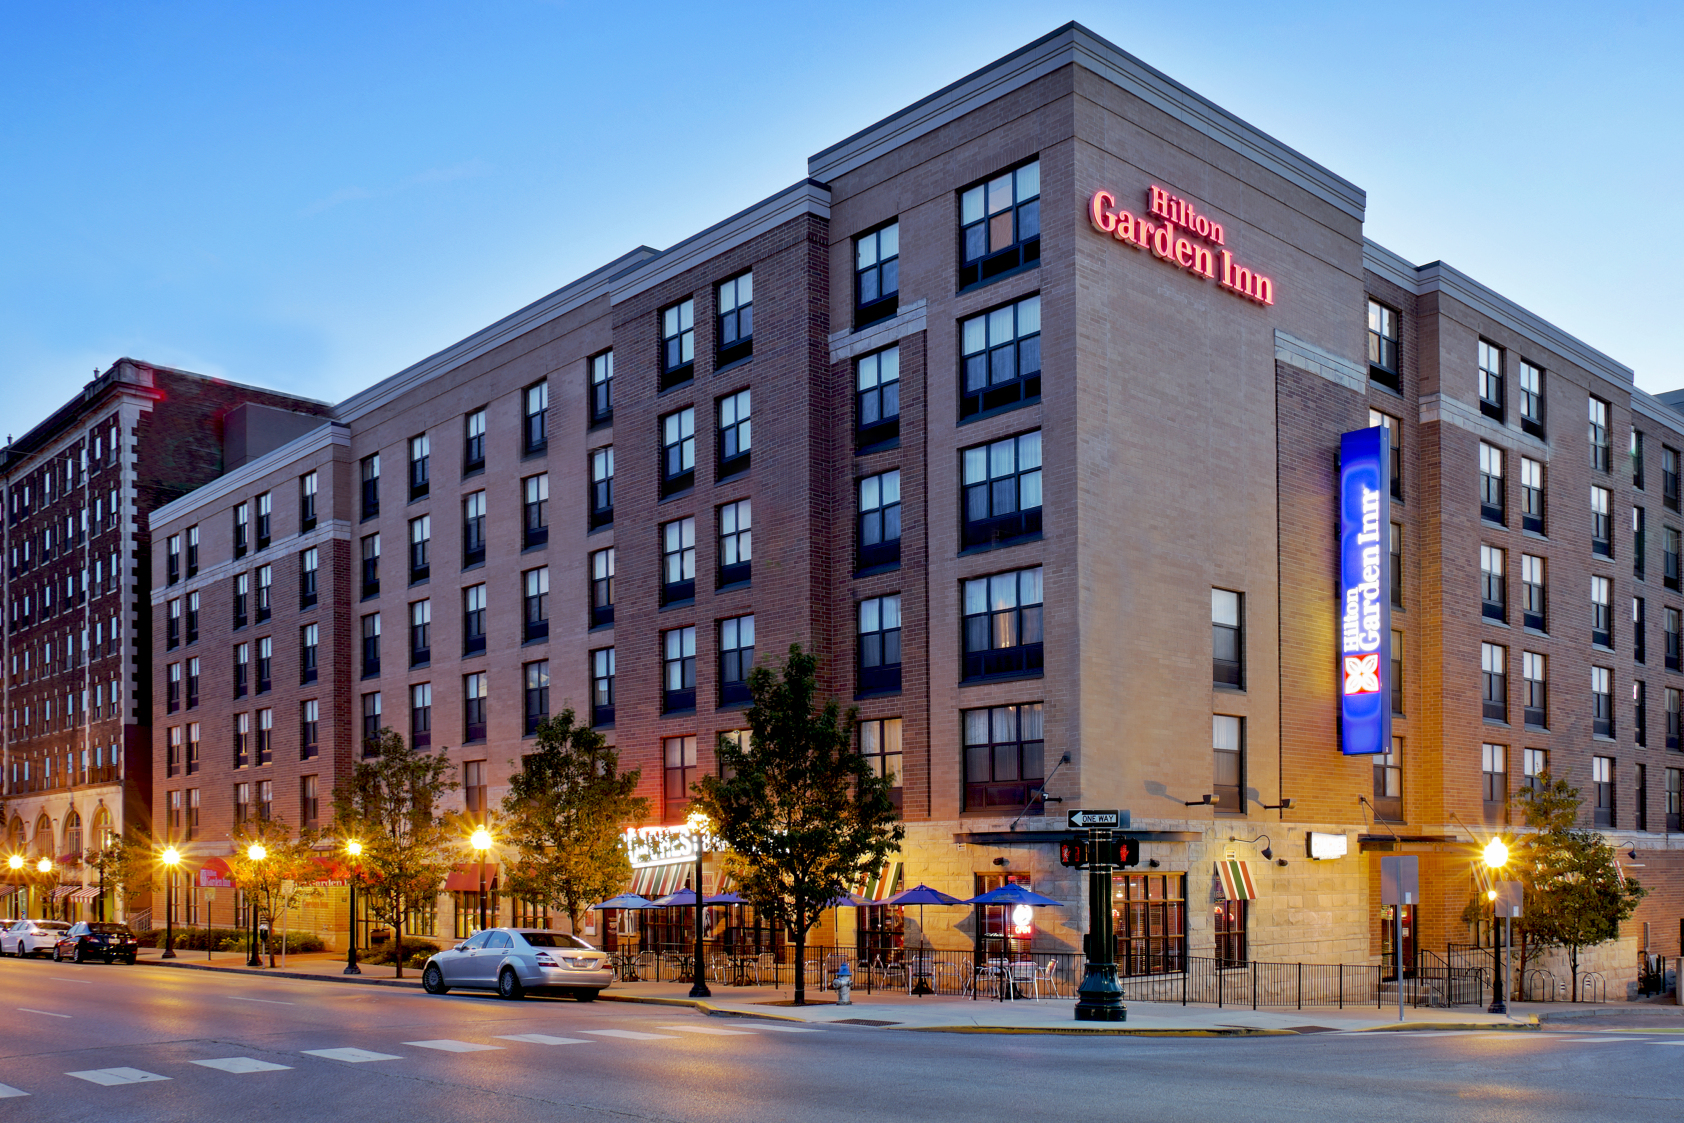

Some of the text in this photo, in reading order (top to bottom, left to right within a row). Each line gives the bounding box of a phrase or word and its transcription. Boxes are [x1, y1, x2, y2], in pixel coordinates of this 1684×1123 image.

[1149, 184, 1225, 246] Hilton
[1090, 190, 1274, 306] Garden Inn
[1358, 490, 1380, 652] Garden Inn
[1344, 587, 1359, 653] Hilton
[1082, 815, 1114, 823] ONE WAY
[1015, 925, 1032, 934] OPEN
